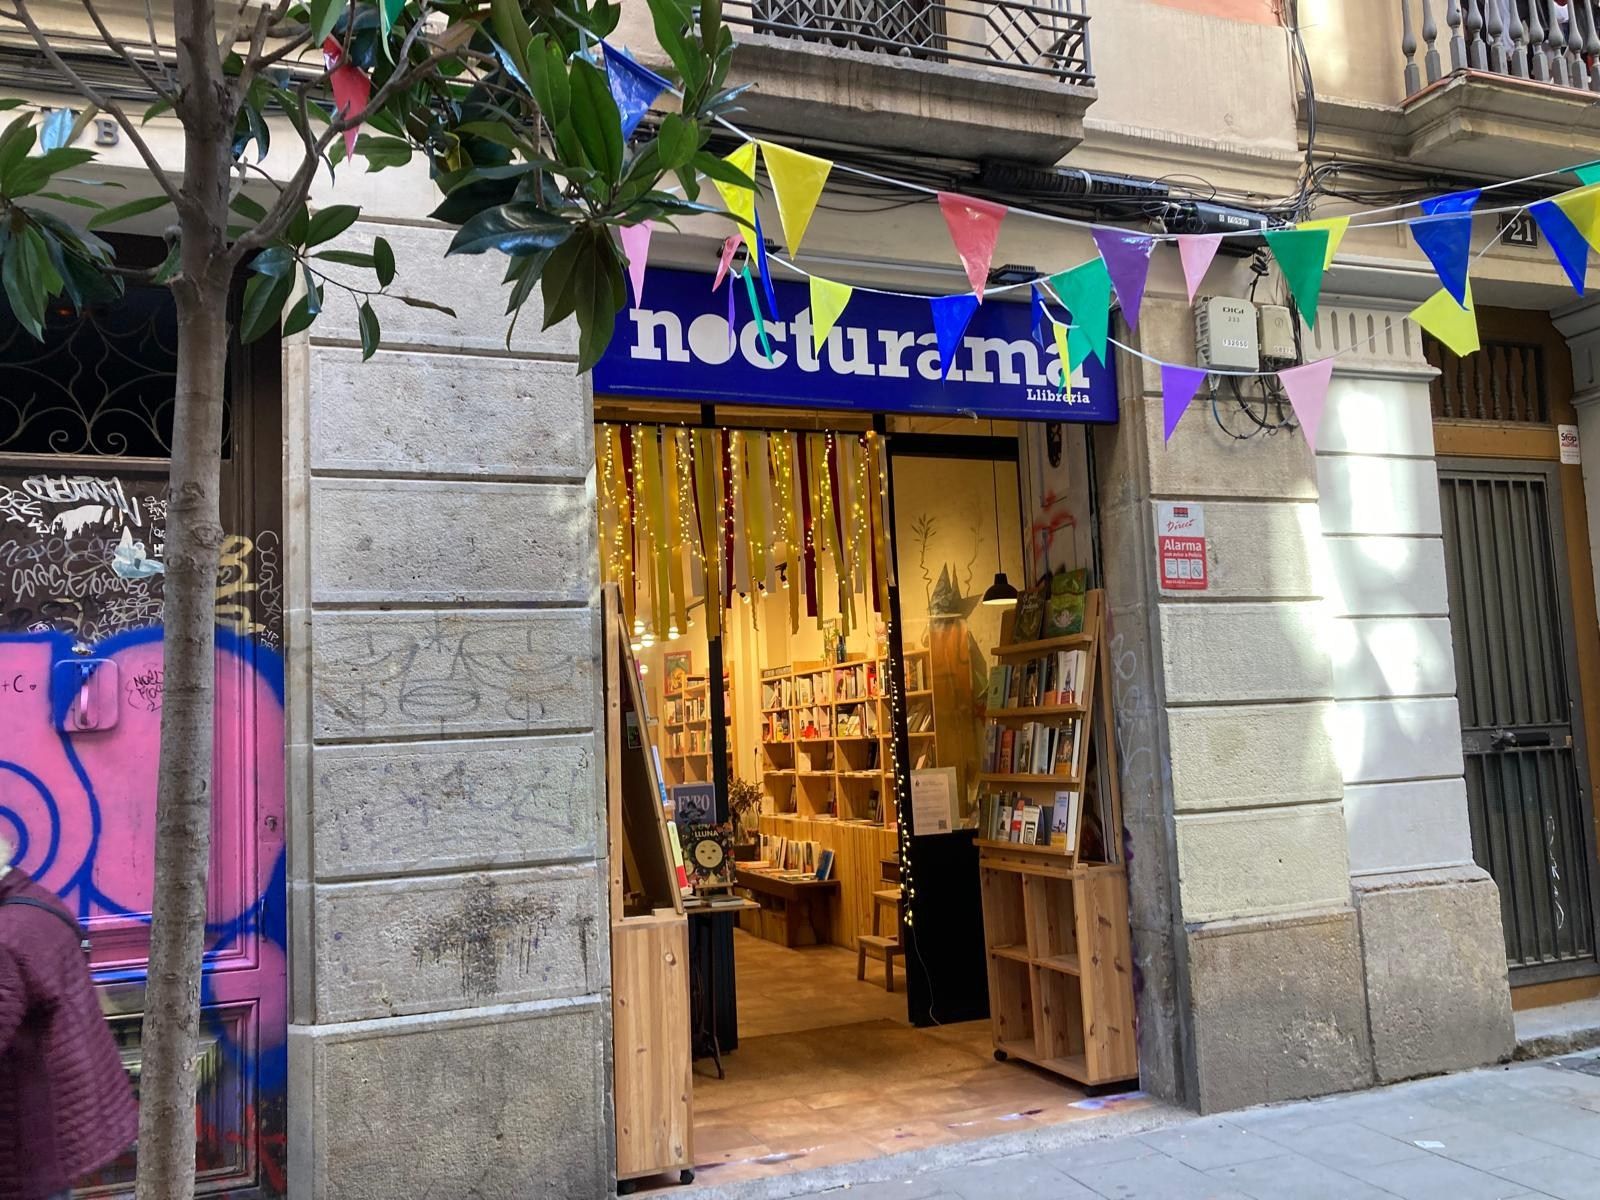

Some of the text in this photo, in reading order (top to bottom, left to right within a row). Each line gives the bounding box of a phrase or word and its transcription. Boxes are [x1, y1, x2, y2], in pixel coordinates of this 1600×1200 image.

[1510, 218, 1532, 241] 21
[629, 307, 1090, 388] nocturama
[1026, 388, 1090, 403] Llibreria
[1164, 539, 1202, 551] Alarma
